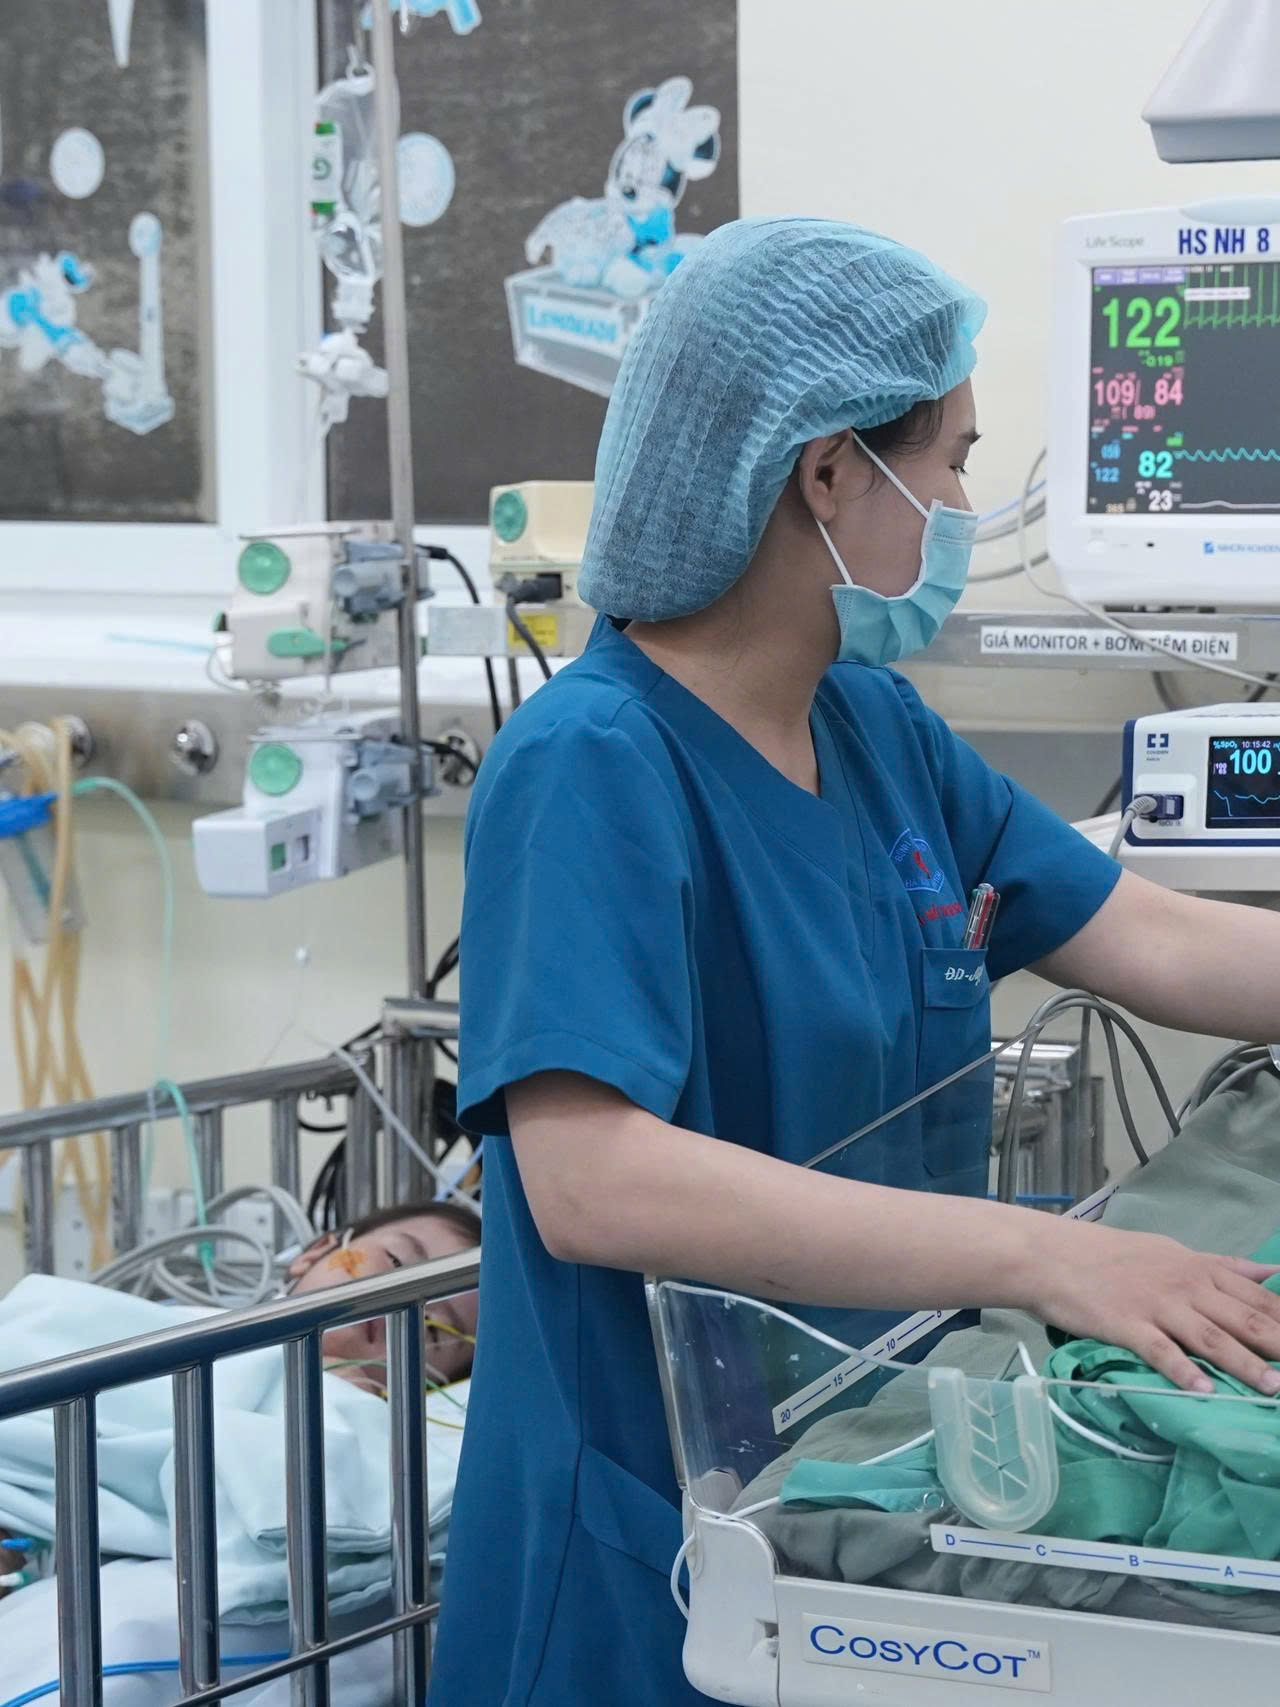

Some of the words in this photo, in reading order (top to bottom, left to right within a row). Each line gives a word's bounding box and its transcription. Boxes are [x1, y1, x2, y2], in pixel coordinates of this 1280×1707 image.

[1179, 228, 1207, 255] HS
[1215, 227, 1245, 254] NH
[1257, 226, 1270, 252] 8
[1102, 296, 1181, 348] 122
[1154, 379, 1183, 405] 84
[1138, 450, 1173, 478] 82
[1148, 489, 1173, 511] 23
[983, 631, 1009, 648] GIÁ
[1014, 634, 1087, 650] MONITOR
[1229, 749, 1272, 774] 100
[886, 1338, 896, 1351] 10
[833, 1373, 843, 1387] 15
[780, 1409, 791, 1423] 20
[945, 1534, 955, 1545] D
[1036, 1544, 1046, 1556] C
[1129, 1555, 1139, 1567] B
[1224, 1565, 1234, 1578] A
